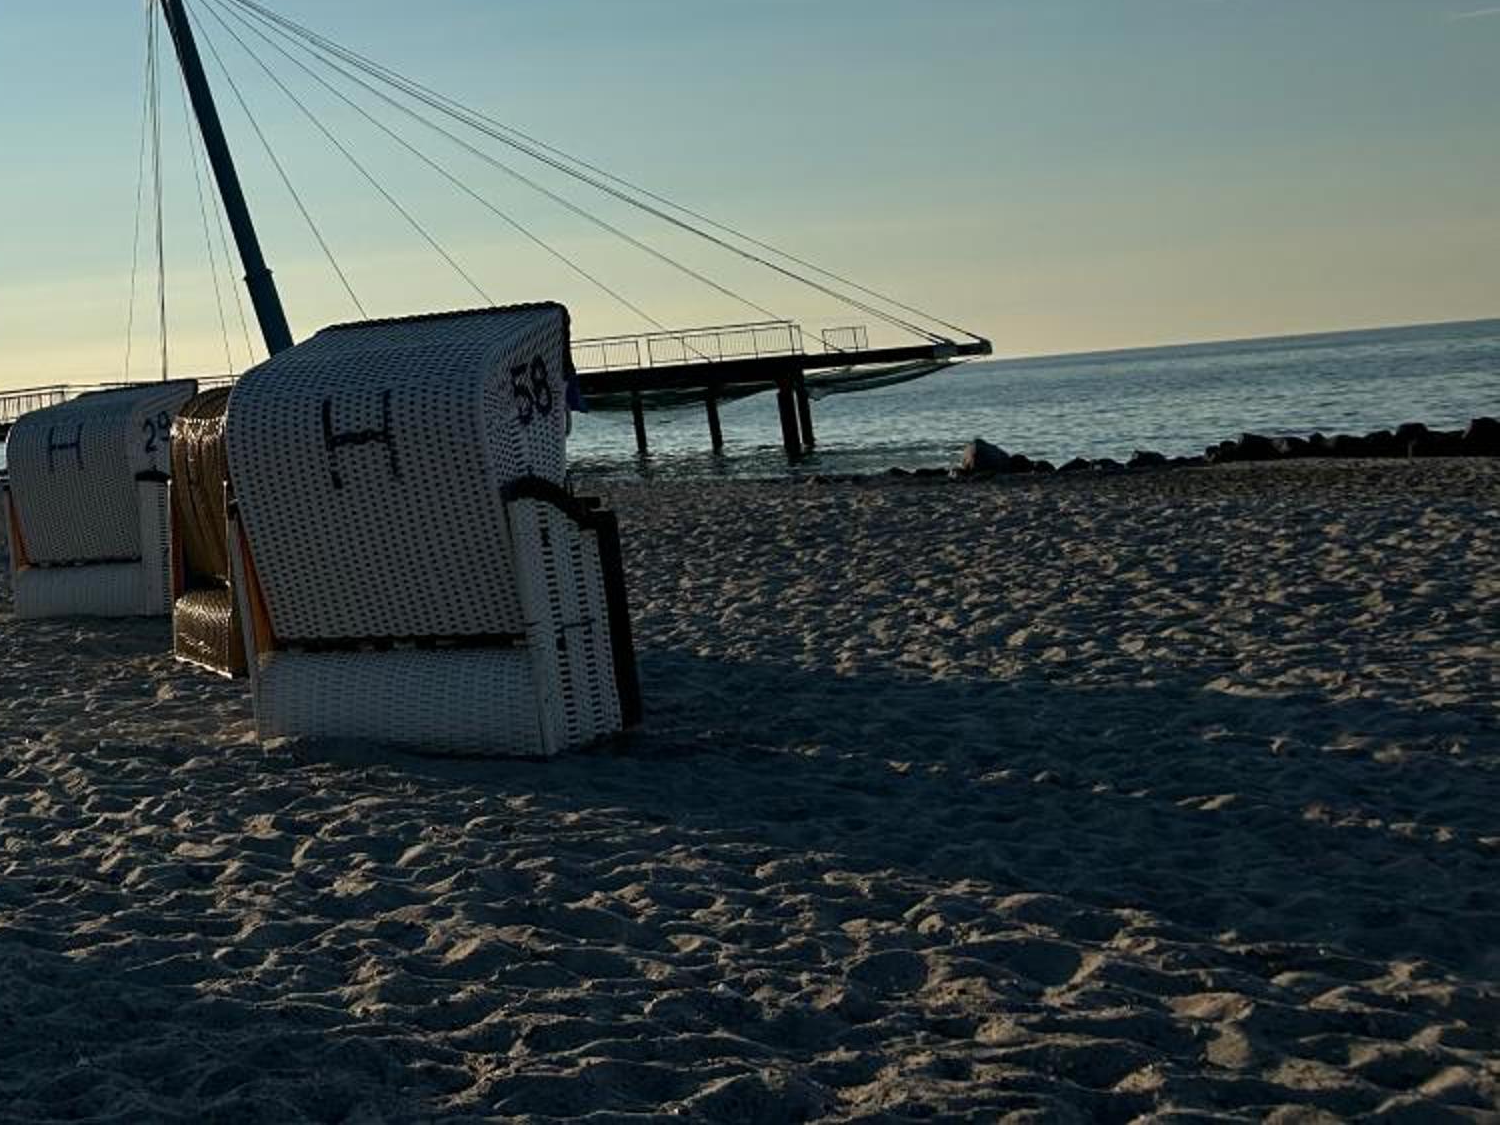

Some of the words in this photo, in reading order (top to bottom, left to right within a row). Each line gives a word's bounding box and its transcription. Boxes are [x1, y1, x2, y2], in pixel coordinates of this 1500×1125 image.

[511, 355, 552, 426] 58
[48, 422, 85, 472] H
[322, 389, 399, 490] H
